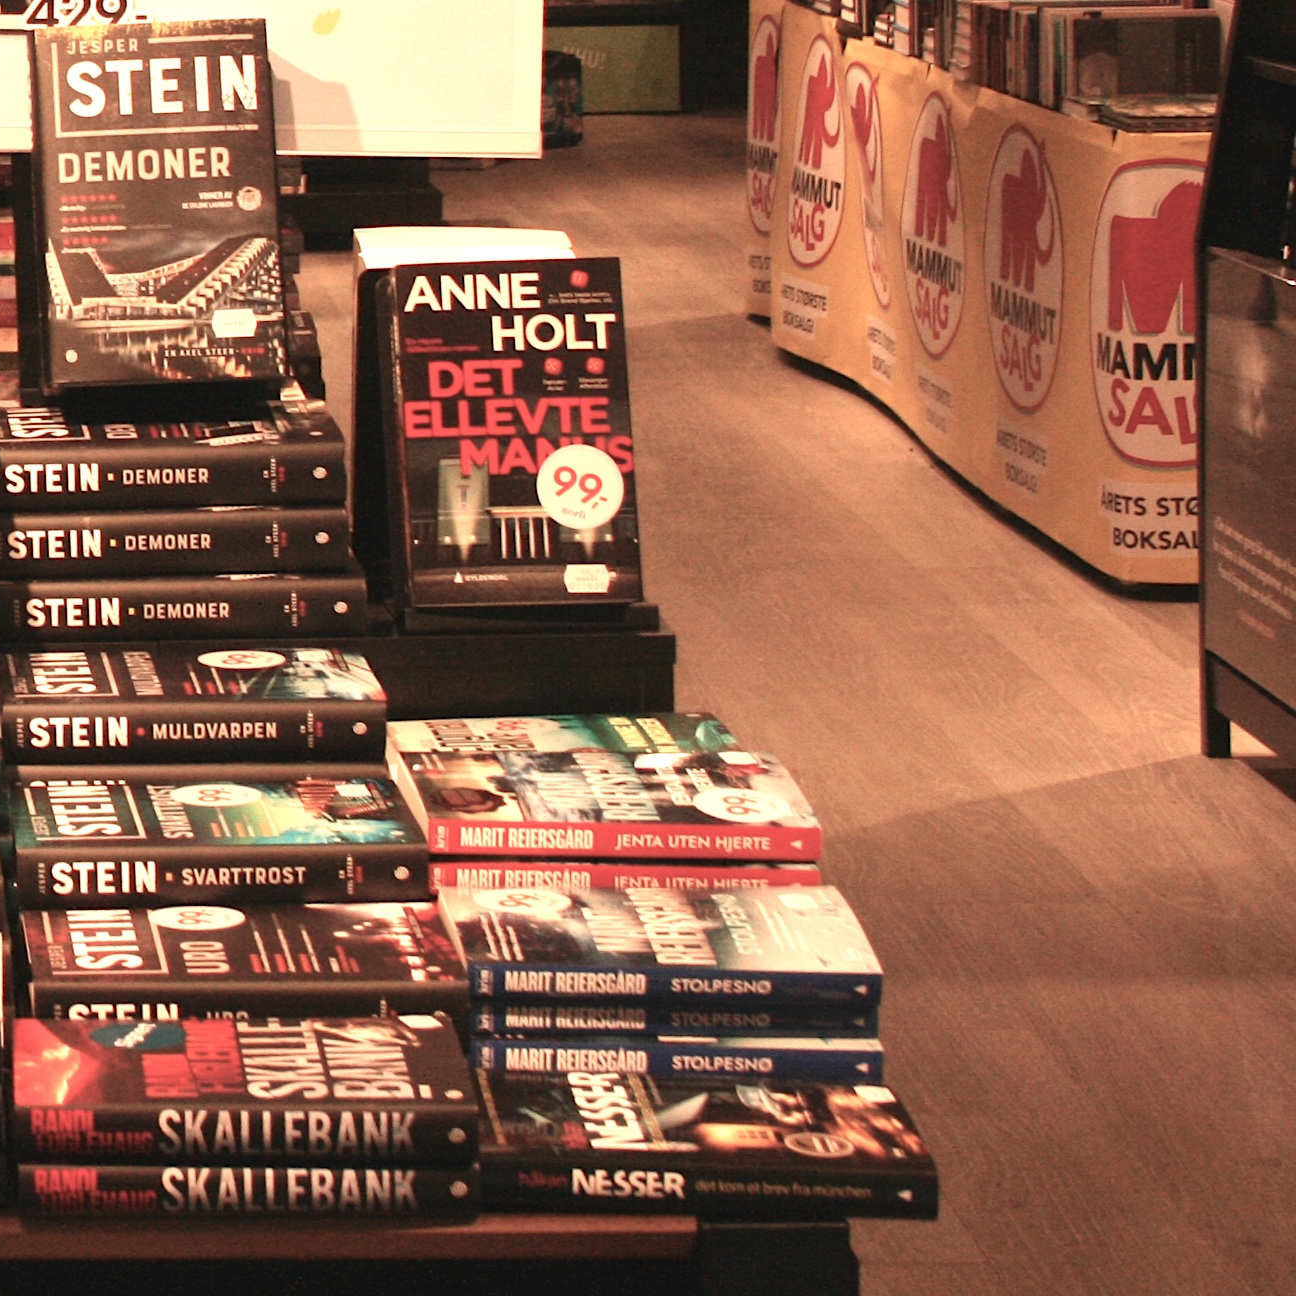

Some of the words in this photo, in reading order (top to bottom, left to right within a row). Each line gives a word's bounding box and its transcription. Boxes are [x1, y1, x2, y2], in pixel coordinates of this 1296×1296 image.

[66, 53, 258, 117] STEIN
[58, 147, 231, 184] DEMONER
[906, 238, 963, 295] MAMMUT
[405, 273, 540, 312] ANNE
[915, 278, 949, 340] SALG
[491, 313, 615, 352] HOLT
[990, 281, 1056, 345] MAMMUT
[1001, 323, 1042, 392] SALG
[429, 359, 522, 397] DET
[407, 396, 609, 439] ELLEVTE
[1108, 378, 1198, 445] SAL
[5, 462, 100, 494] STEIN
[122, 467, 208, 486] DEMONER
[552, 465, 608, 510] 99,-
[1113, 527, 1200, 549] BOKSAL
[29, 716, 129, 749] STEIN
[153, 721, 278, 740] MULDVARPEN
[460, 827, 505, 849] MARIT
[507, 824, 594, 850] REIERSGÅRD
[615, 834, 664, 851] JENTA
[668, 835, 712, 850] UTEN
[715, 835, 772, 852] HJERTE
[671, 977, 772, 995] STOLPESNØ
[158, 1109, 417, 1156] SKALLEBANK
[571, 1167, 686, 1198] NESSER
